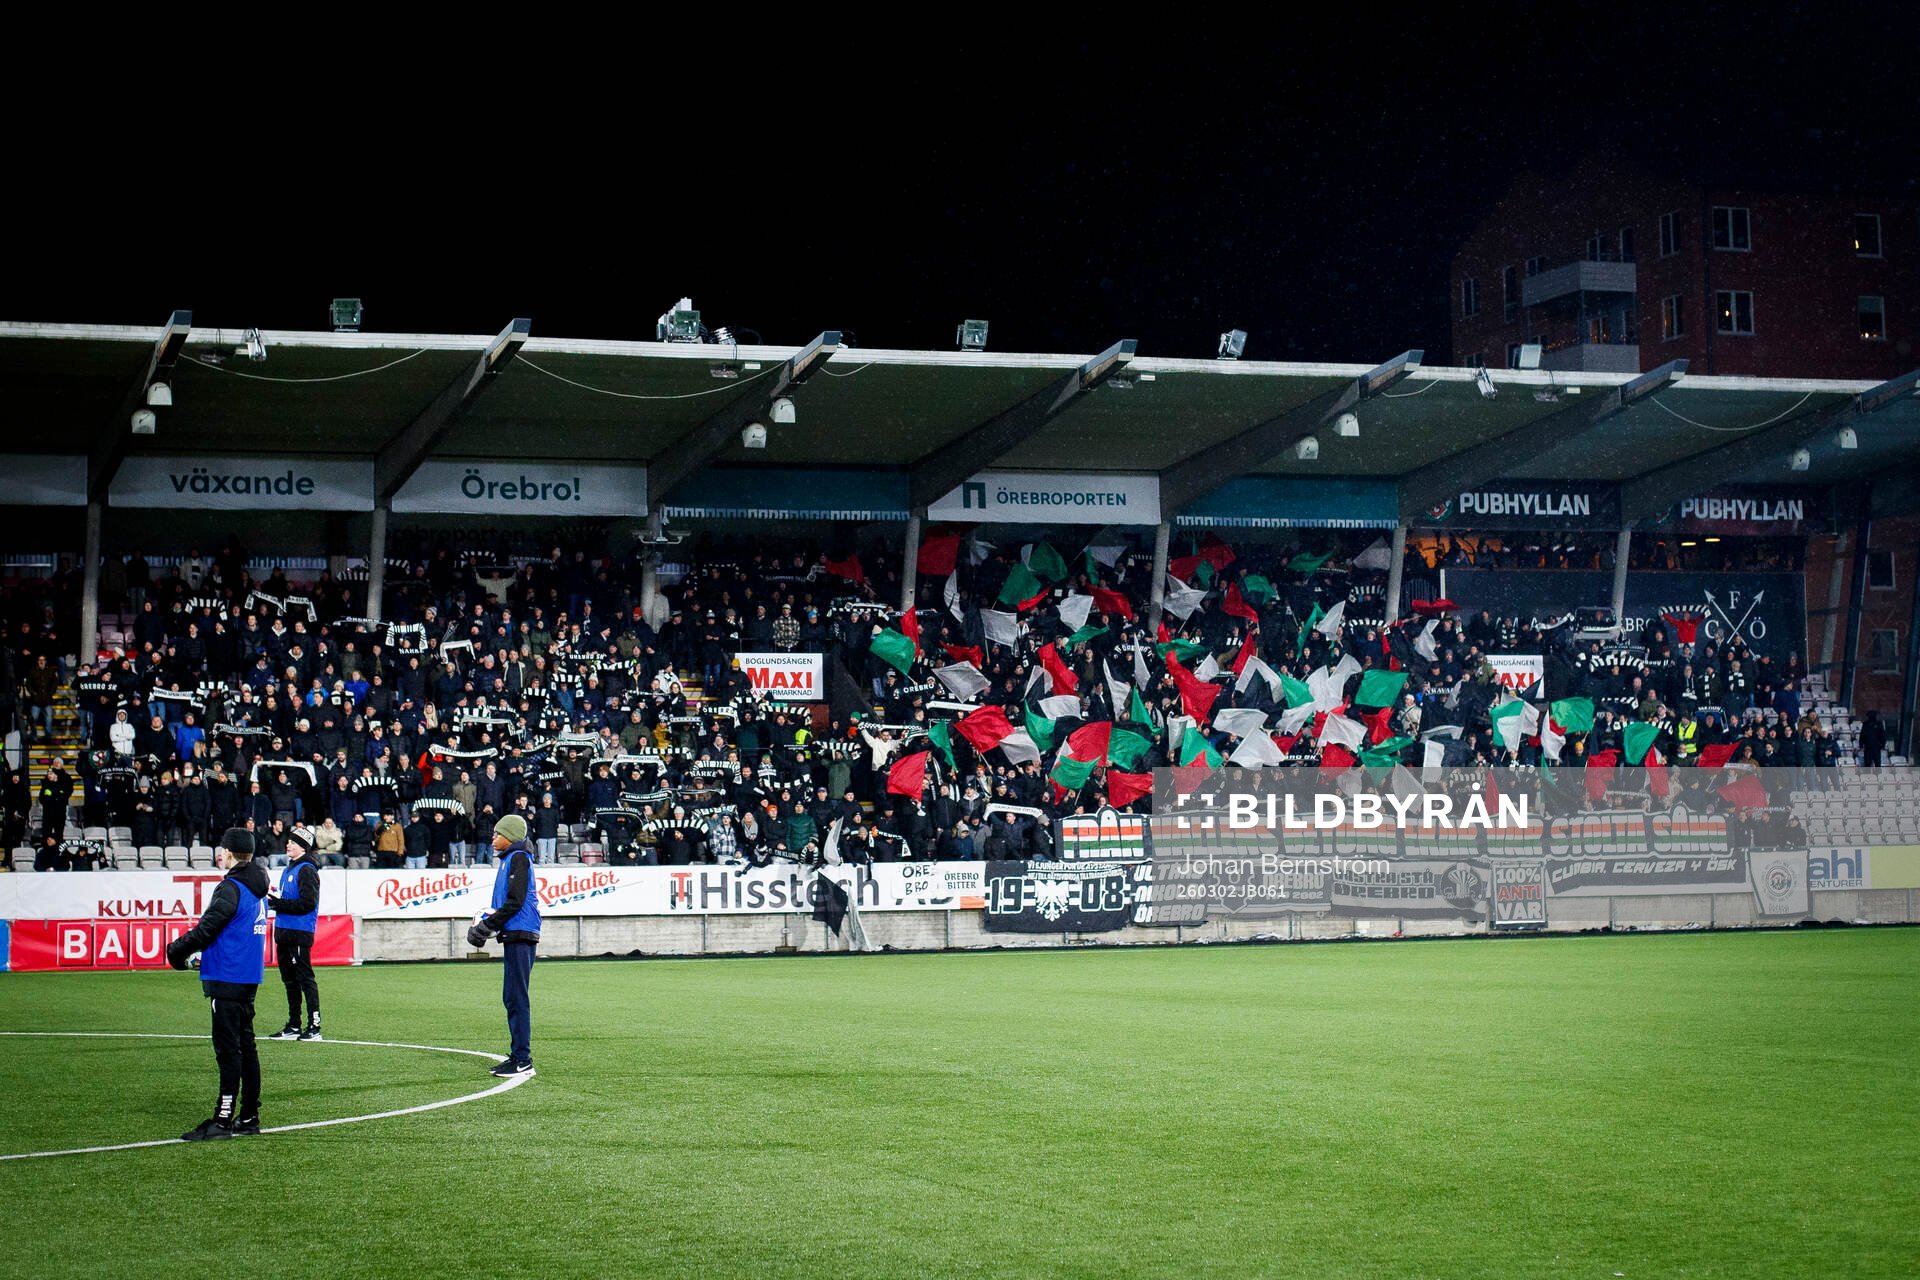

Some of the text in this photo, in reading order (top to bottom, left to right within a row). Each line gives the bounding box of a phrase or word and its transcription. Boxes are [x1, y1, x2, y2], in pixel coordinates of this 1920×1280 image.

[169, 468, 314, 495] växande
[461, 468, 580, 501] Örebro!
[997, 487, 1126, 505] ÖREBROPORTEN
[1460, 492, 1590, 516] PUBHYLLAN
[1681, 498, 1803, 521] PUBHYLLAN
[1729, 591, 1741, 610] F
[745, 657, 812, 665] BOGLUNDSÄNGEN
[746, 667, 812, 689] MAXI
[1500, 672, 1534, 688] AXI
[1063, 810, 1144, 859] FRÅN
[1612, 859, 1685, 874] CERVEZA
[1690, 859, 1700, 872] Y
[1706, 856, 1738, 872] ÖSK
[1809, 849, 1862, 880] ahl
[944, 872, 979, 881] ÖREBRO
[947, 881, 977, 890] BITTER
[1496, 867, 1541, 884] 100%
[1810, 879, 1863, 888] ENTURER
[377, 872, 473, 907] Radiator
[399, 887, 469, 910] VVS AB
[536, 870, 620, 907] Radiator
[547, 886, 616, 908] VVS AB
[989, 876, 1024, 915] 19
[1497, 883, 1541, 901] ANTI
[97, 899, 188, 917] KUMLA
[1134, 903, 1205, 923] ÖREBRO
[1497, 901, 1542, 920] VAR
